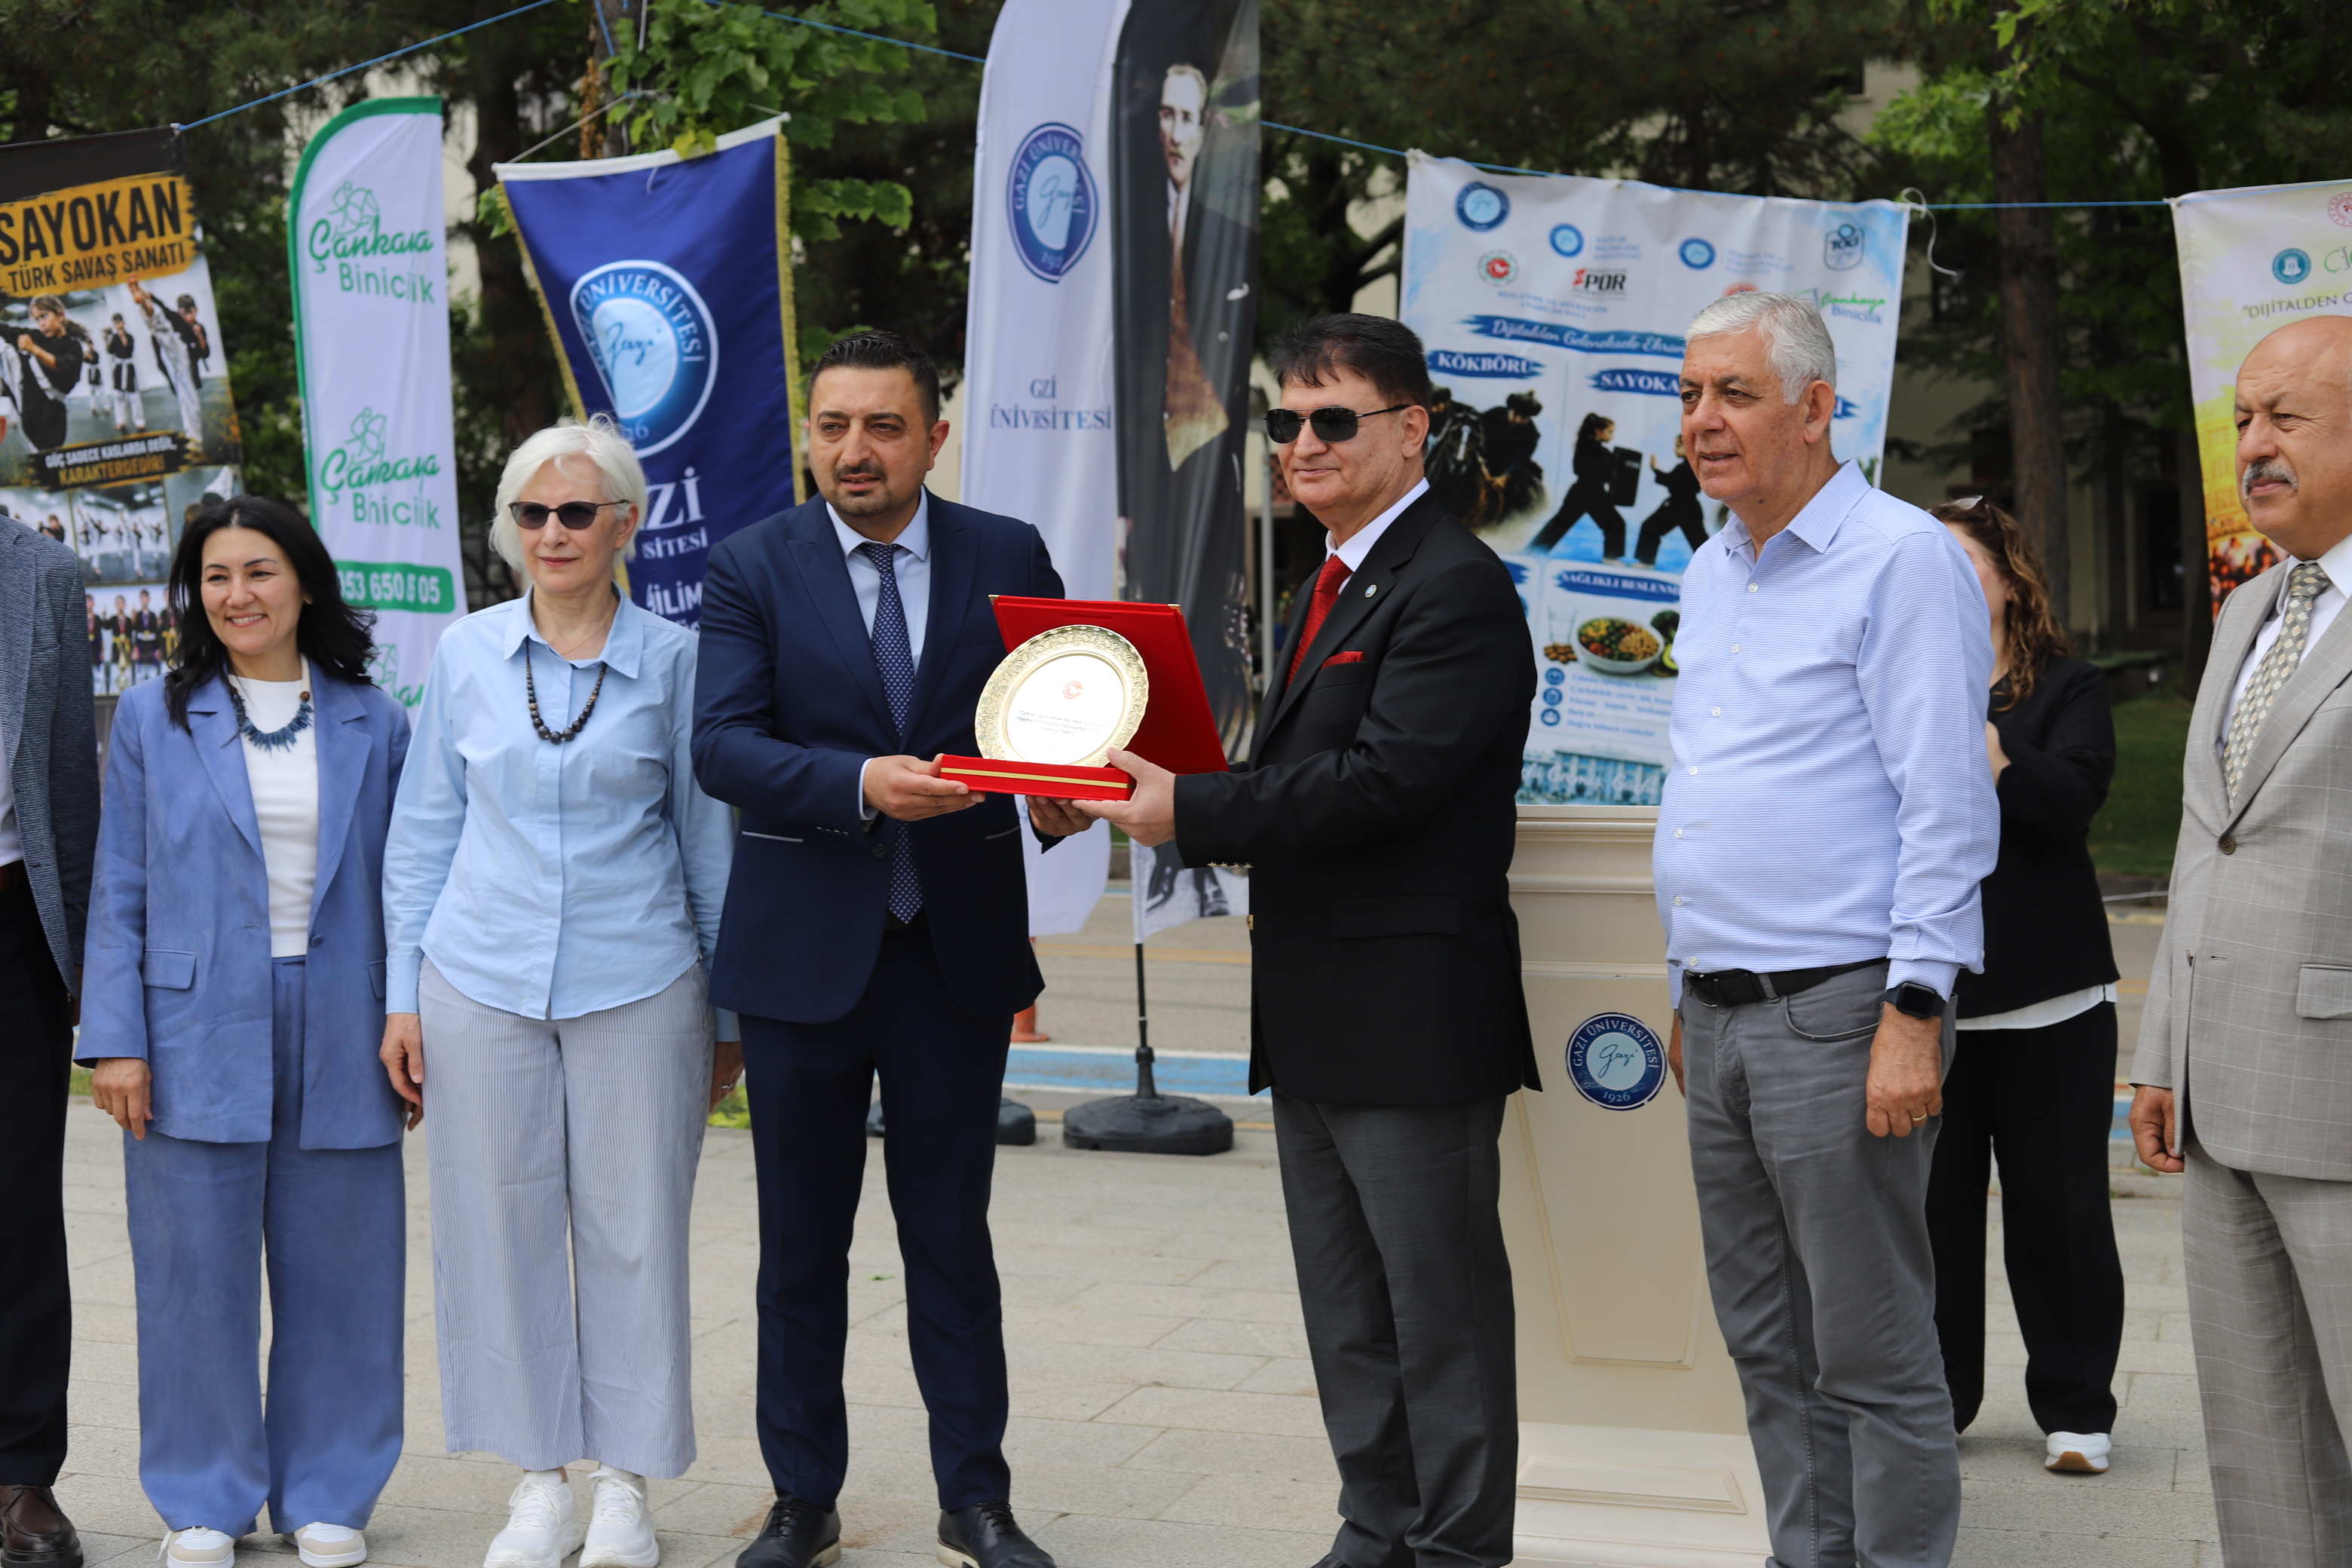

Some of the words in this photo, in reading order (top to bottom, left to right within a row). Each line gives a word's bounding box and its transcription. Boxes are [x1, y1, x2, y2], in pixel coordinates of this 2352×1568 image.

[0, 180, 182, 266] SAYOKAN
[8, 264, 58, 292] TÜRK
[60, 254, 118, 283] SAVAŞ
[121, 241, 185, 273] SANATI
[1573, 268, 1628, 292] SPOR
[578, 272, 706, 364] ÜNİVERSİTESİ
[369, 571, 405, 602] 650
[417, 574, 442, 605] 05
[1573, 1035, 1588, 1067] GAZİ
[1586, 1019, 1660, 1068] ÜNİVERSİTESİ
[1603, 1092, 1631, 1103] 1926
